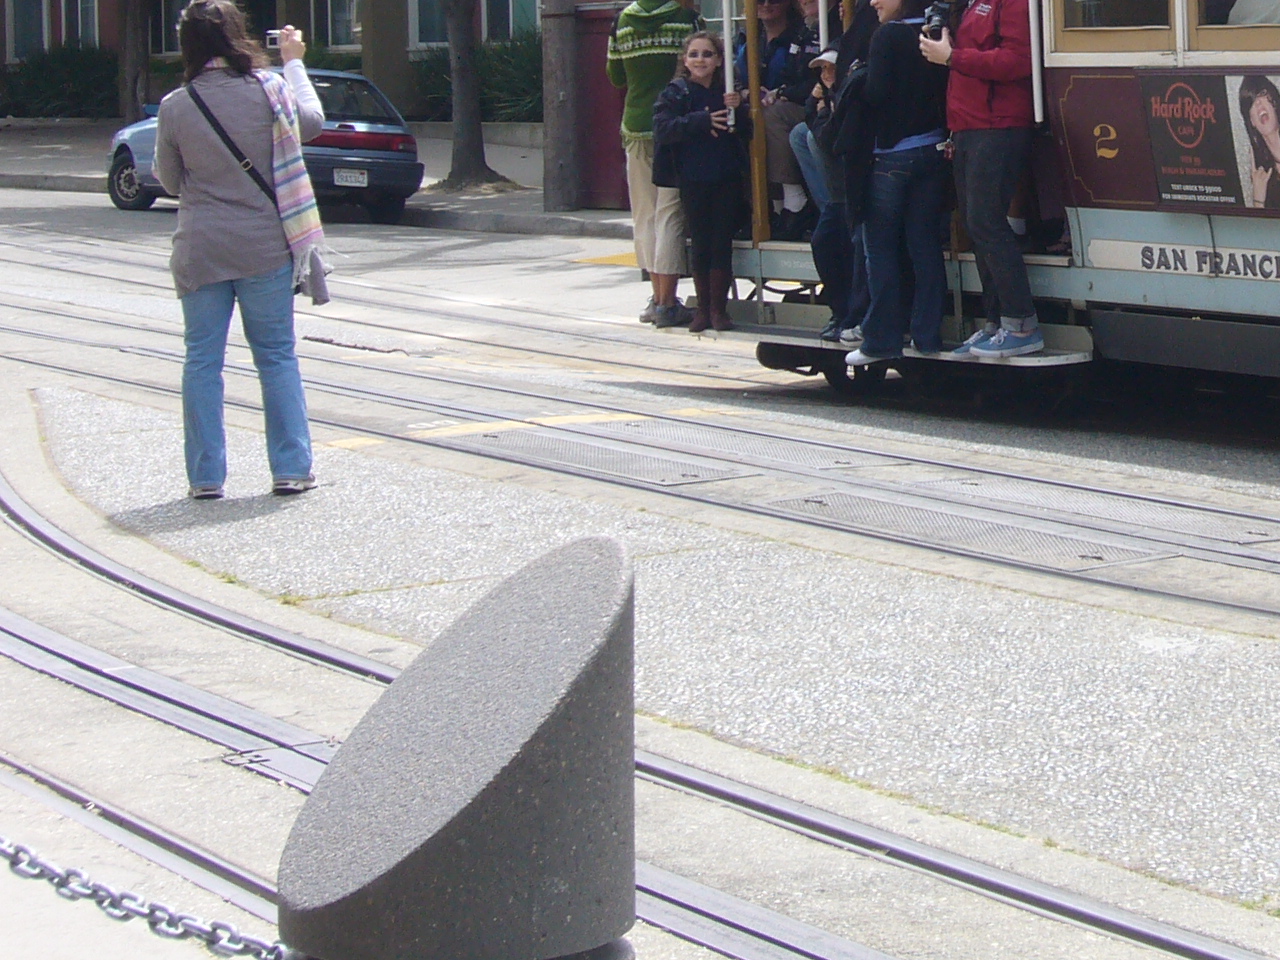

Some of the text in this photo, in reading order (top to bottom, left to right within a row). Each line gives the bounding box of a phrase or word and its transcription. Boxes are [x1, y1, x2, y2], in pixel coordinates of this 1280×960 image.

[1151, 95, 1217, 124] Hard Rock
[1093, 123, 1119, 159] 2
[1140, 245, 1188, 272] SAN
